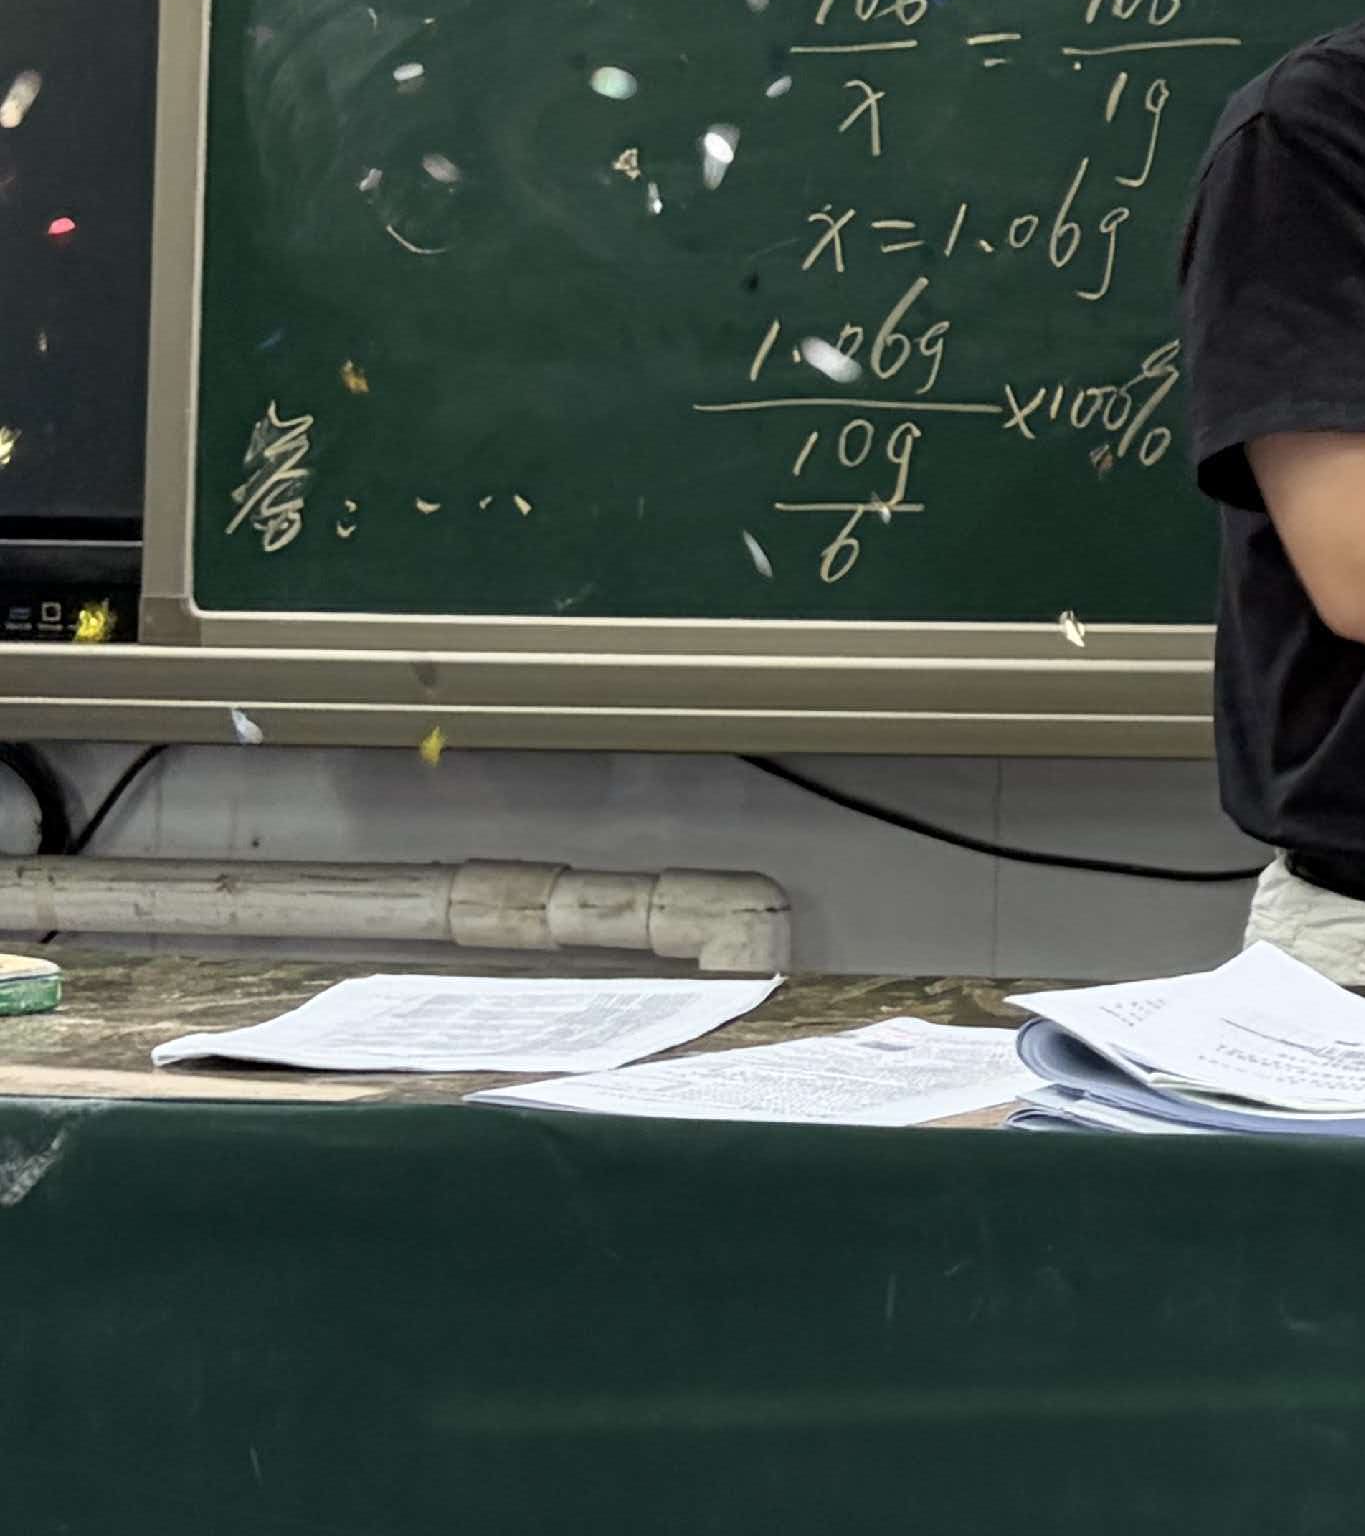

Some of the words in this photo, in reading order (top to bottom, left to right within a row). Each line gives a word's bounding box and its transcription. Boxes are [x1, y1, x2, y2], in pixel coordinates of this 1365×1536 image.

[839, 79, 887, 157] x
[1105, 71, 1170, 187] 1g
[793, 419, 923, 507] 10g
